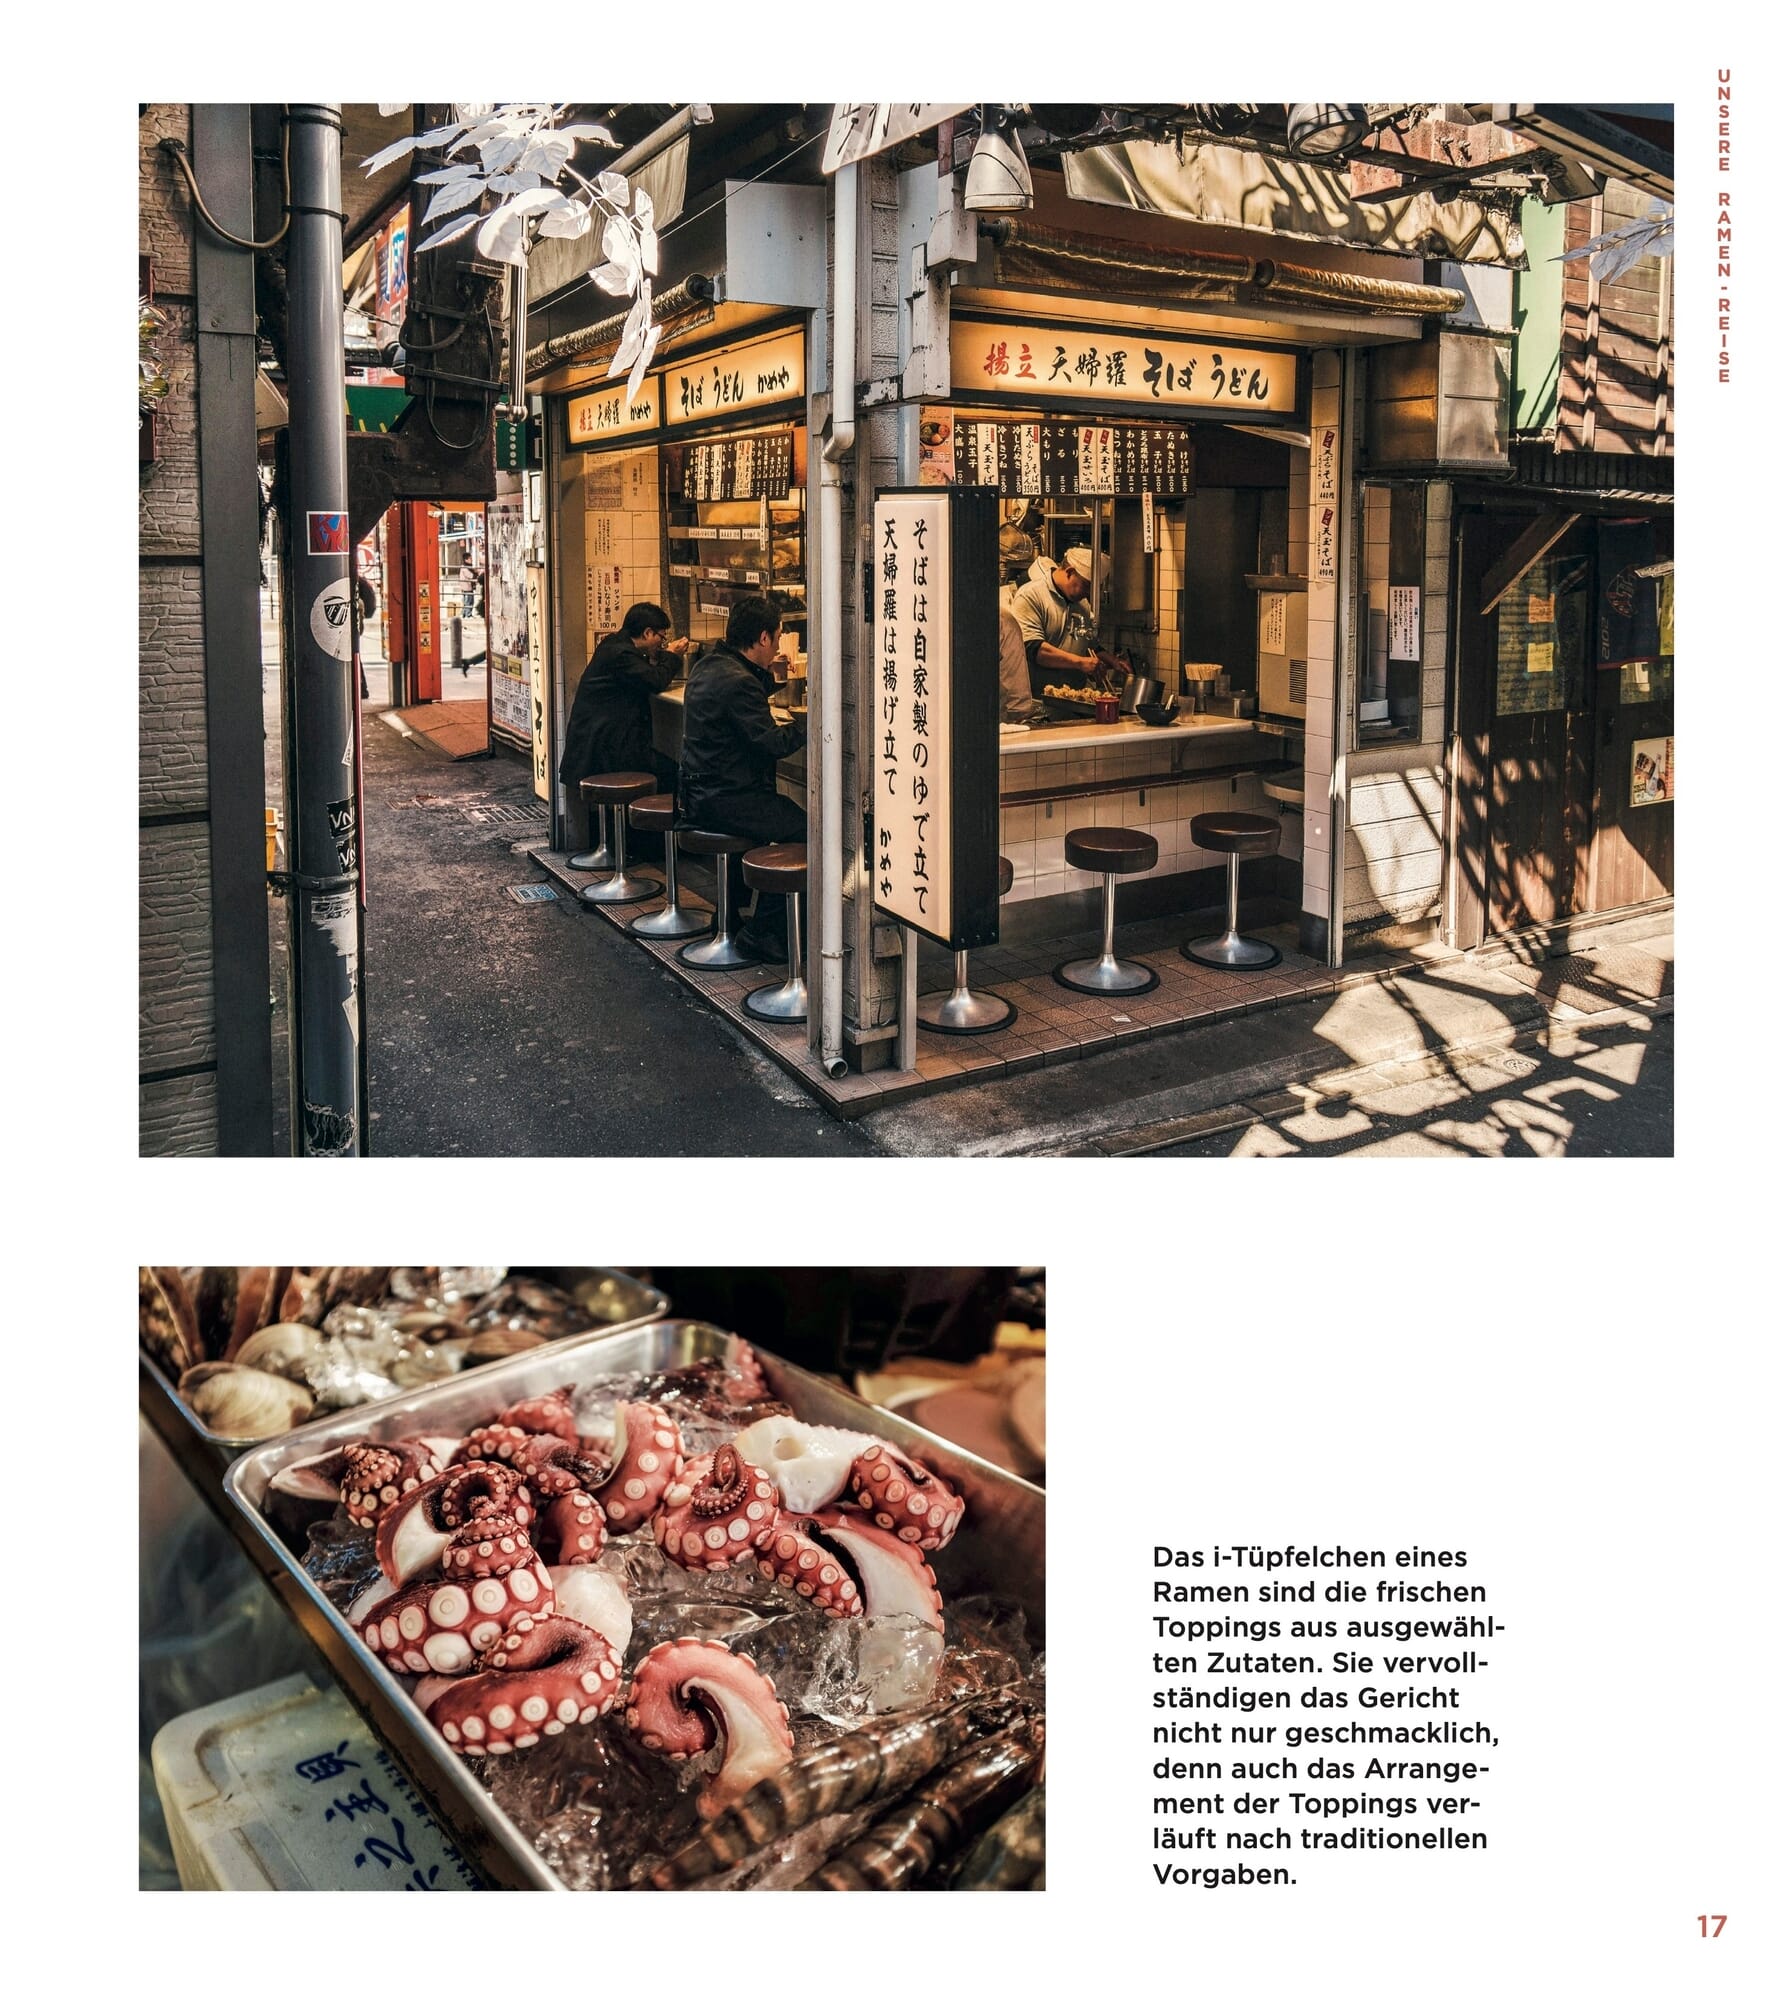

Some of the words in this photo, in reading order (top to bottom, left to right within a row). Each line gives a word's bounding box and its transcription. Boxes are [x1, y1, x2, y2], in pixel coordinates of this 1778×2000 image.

[681, 375, 705, 417] そば
[713, 366, 745, 407] うどん
[757, 366, 790, 395] かめや
[984, 343, 1038, 380] 揚立
[1047, 347, 1129, 387] 天婦羅
[1142, 348, 1198, 398] そば
[1210, 354, 1270, 401] うどん
[630, 400, 653, 422] かめや
[1321, 526, 1333, 566] 天玉そば
[882, 518, 898, 795] 天婦羅は揚げ立て
[912, 518, 930, 914] そばは自家製のゆで立て
[879, 827, 893, 898] かめや
